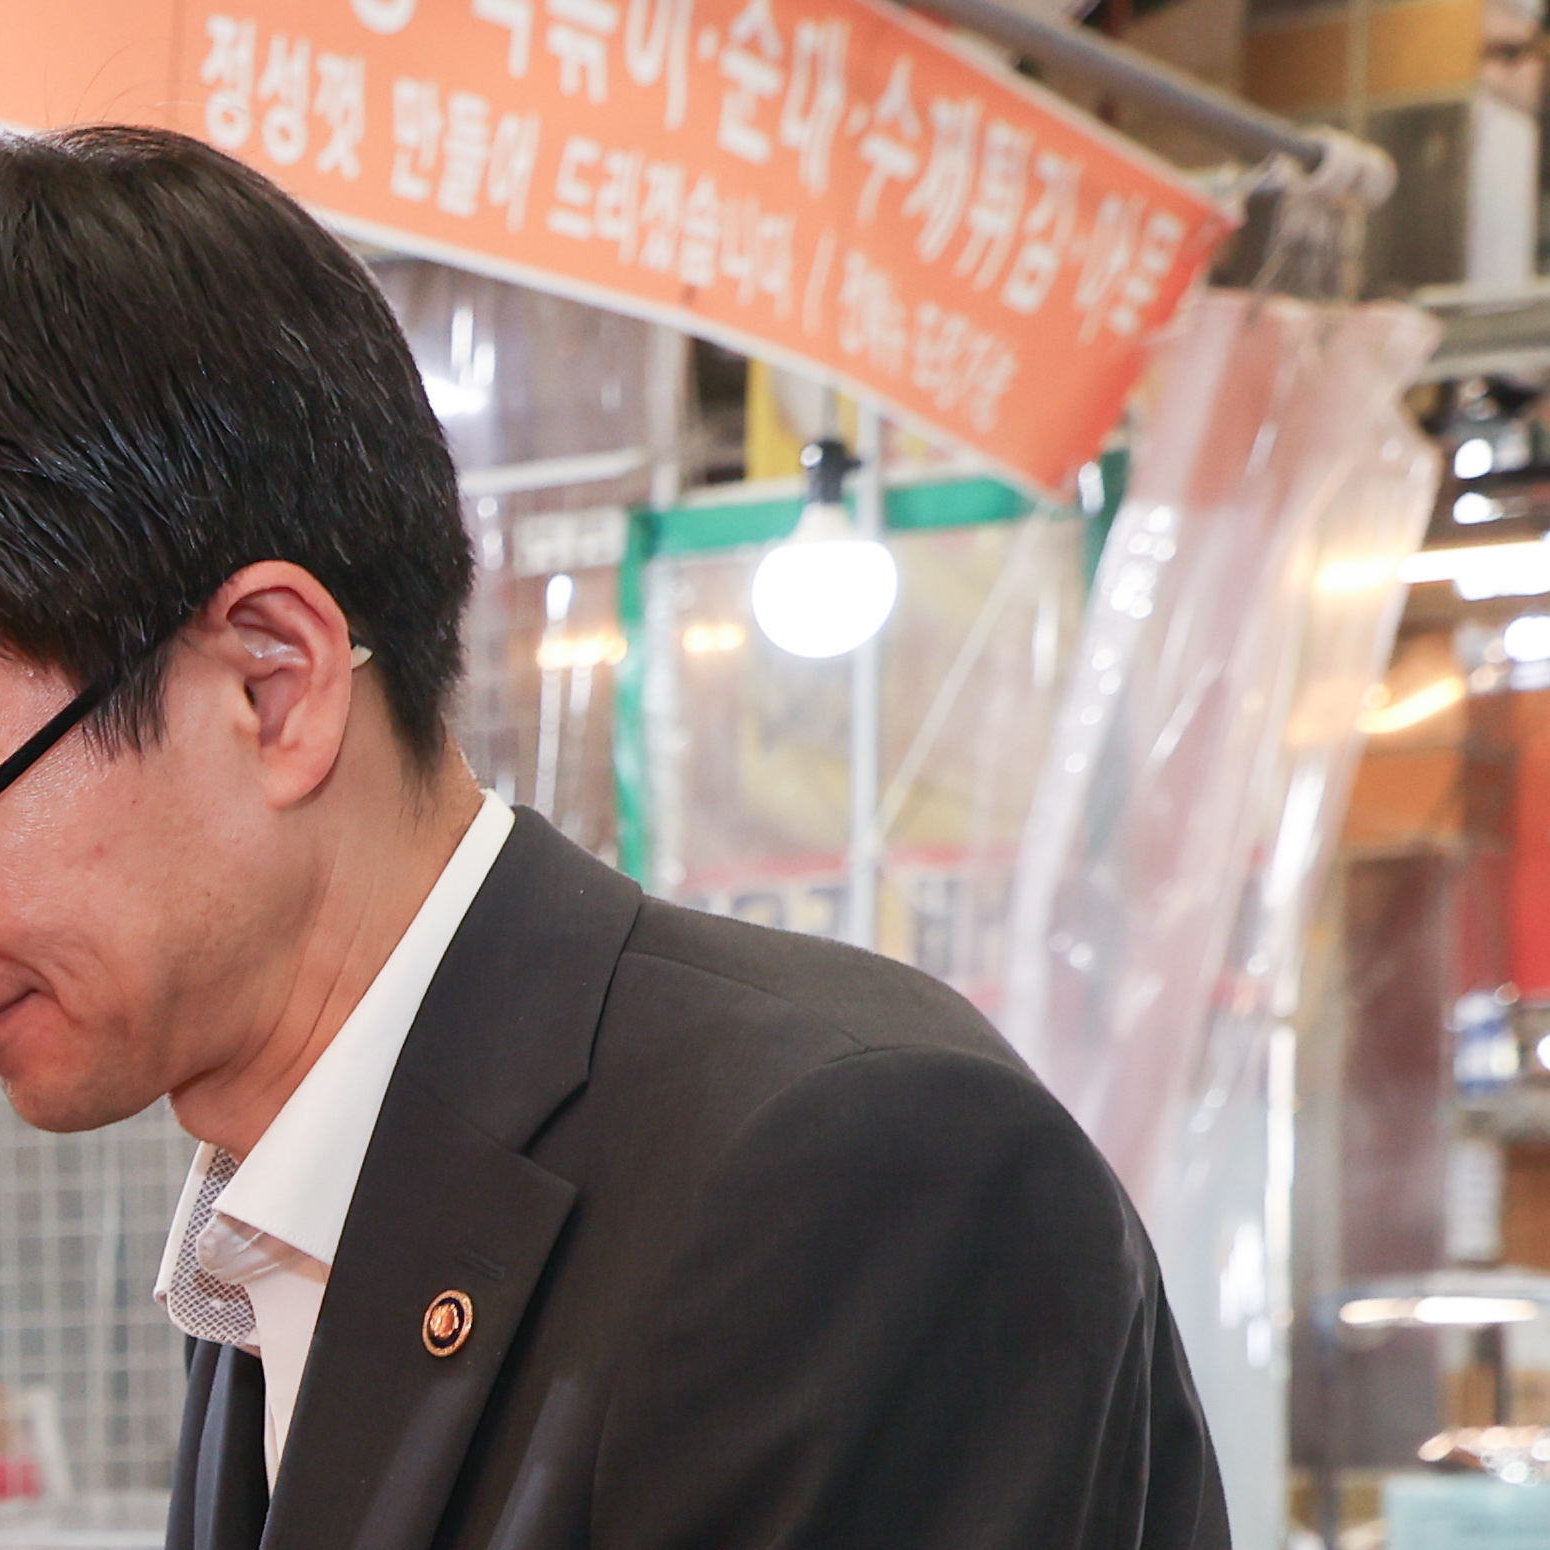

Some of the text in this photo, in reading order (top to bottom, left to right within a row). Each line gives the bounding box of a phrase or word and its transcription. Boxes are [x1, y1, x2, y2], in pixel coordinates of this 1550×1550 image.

[199, 14, 366, 182] 정성껏
[390, 76, 541, 233] 만들어
[545, 135, 797, 321] 드리겠습니다
